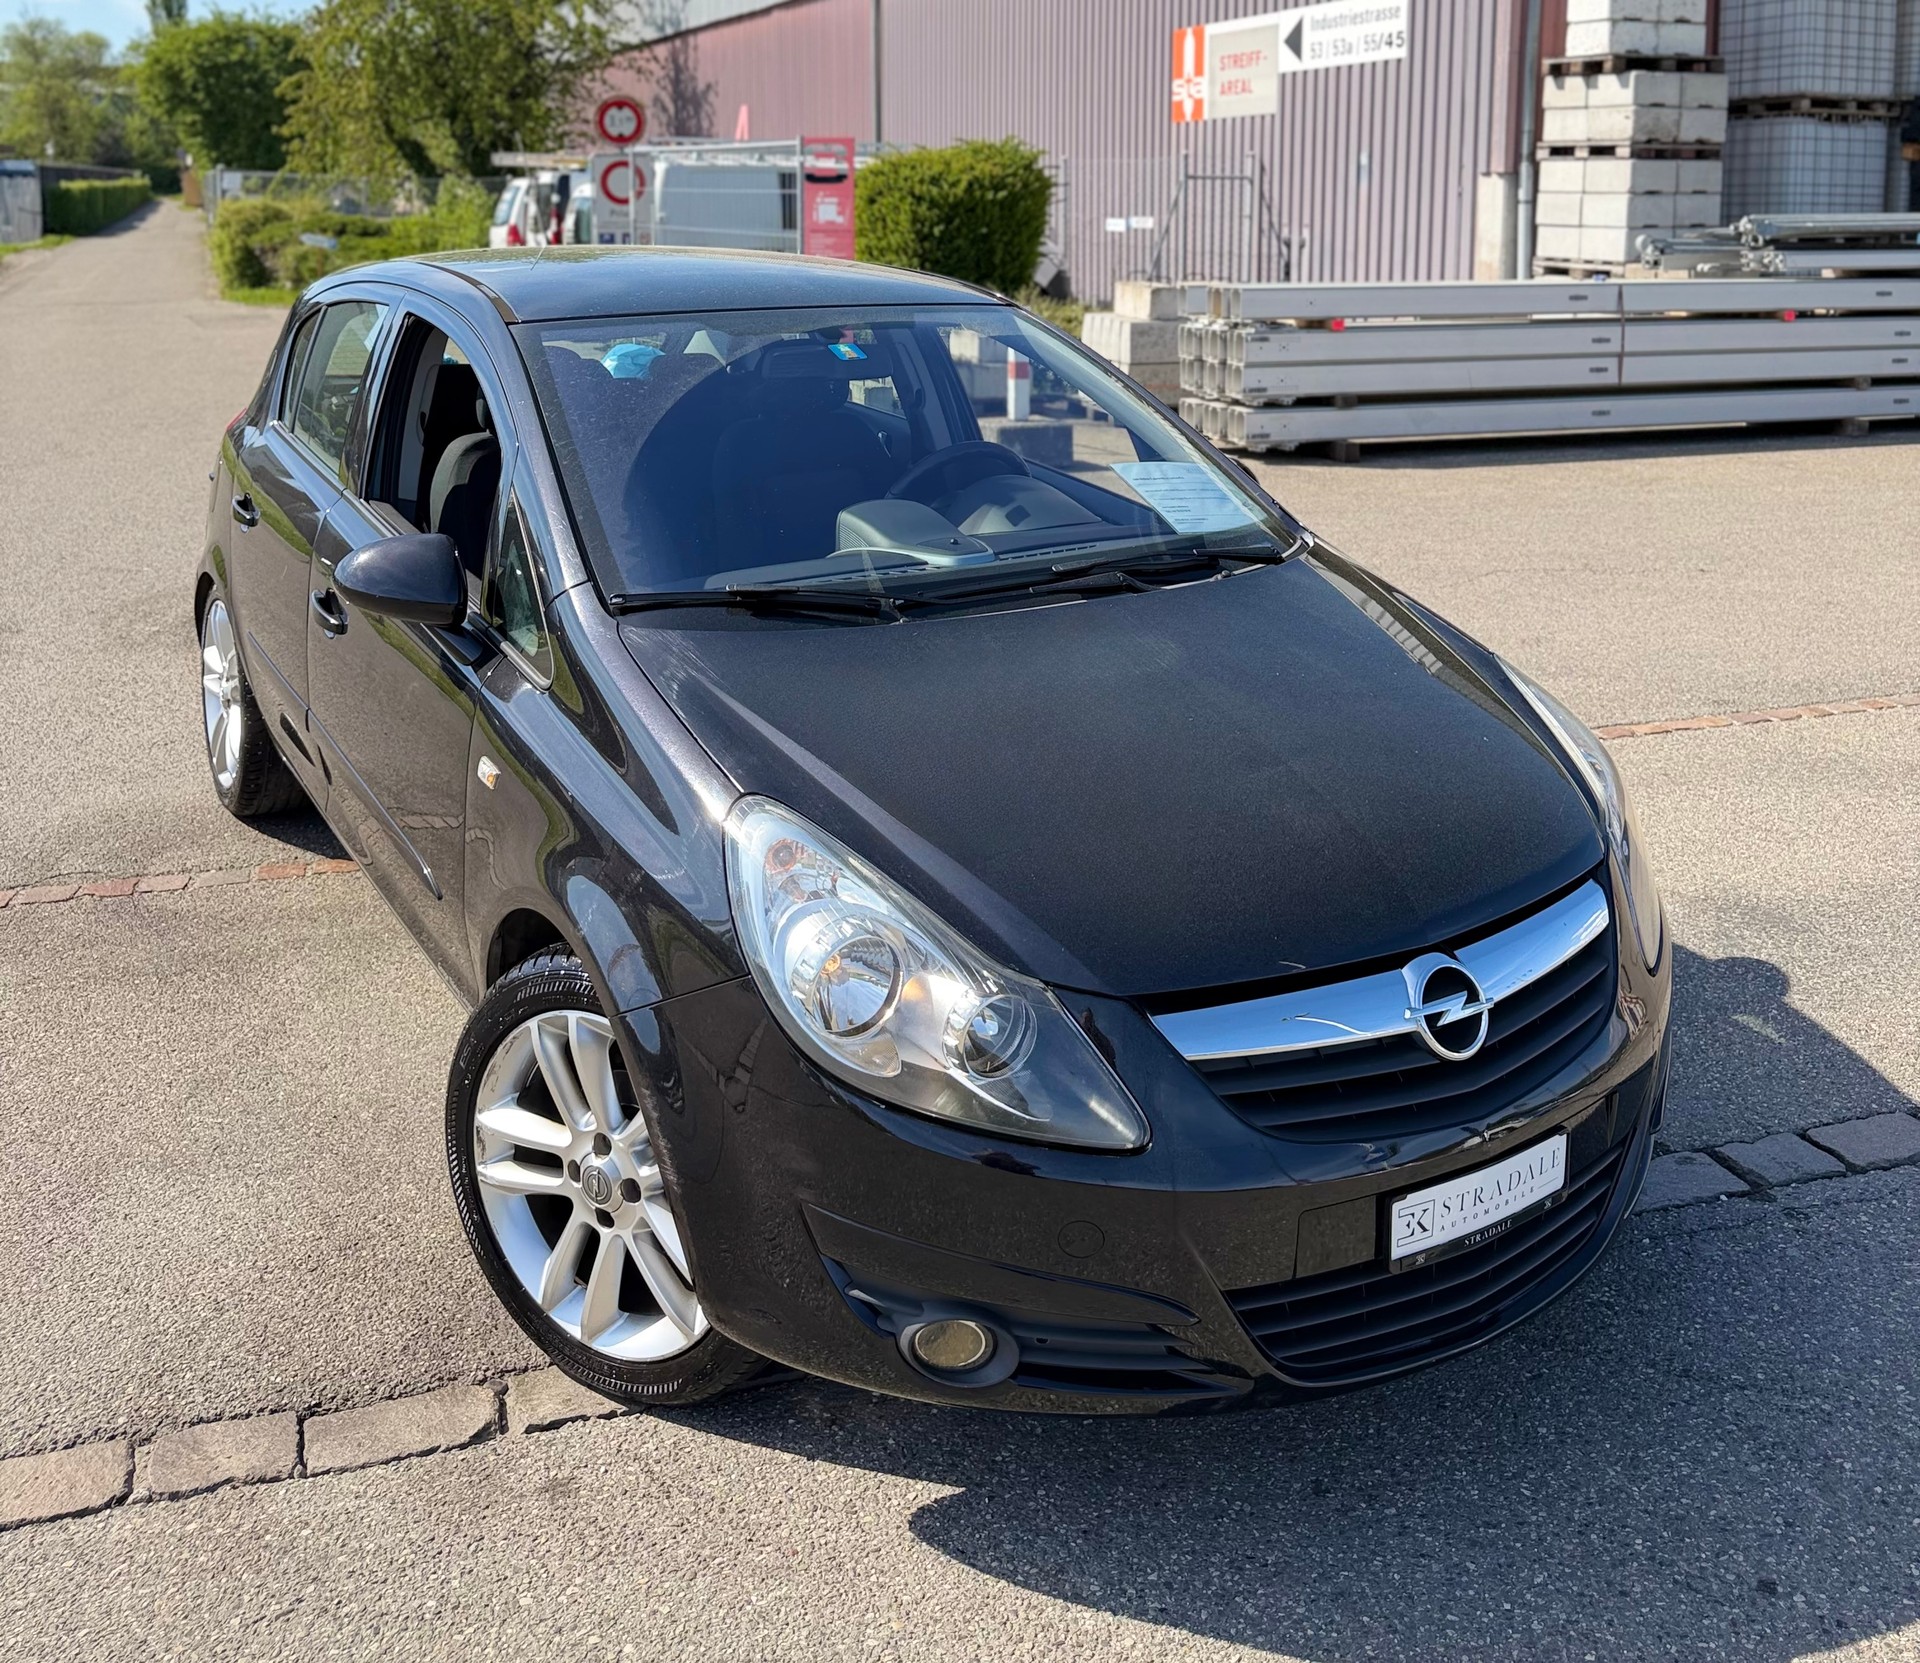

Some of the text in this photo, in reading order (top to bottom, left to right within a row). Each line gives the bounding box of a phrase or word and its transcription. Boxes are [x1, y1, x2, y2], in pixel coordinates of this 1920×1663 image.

[1310, 6, 1401, 31] Industriestrasse
[1219, 78, 1253, 96] AREAL
[1440, 1147, 1561, 1218] STRADALE
[1439, 1186, 1536, 1232] AUTOMOBILE
[1464, 1219, 1512, 1247] STRADALE
